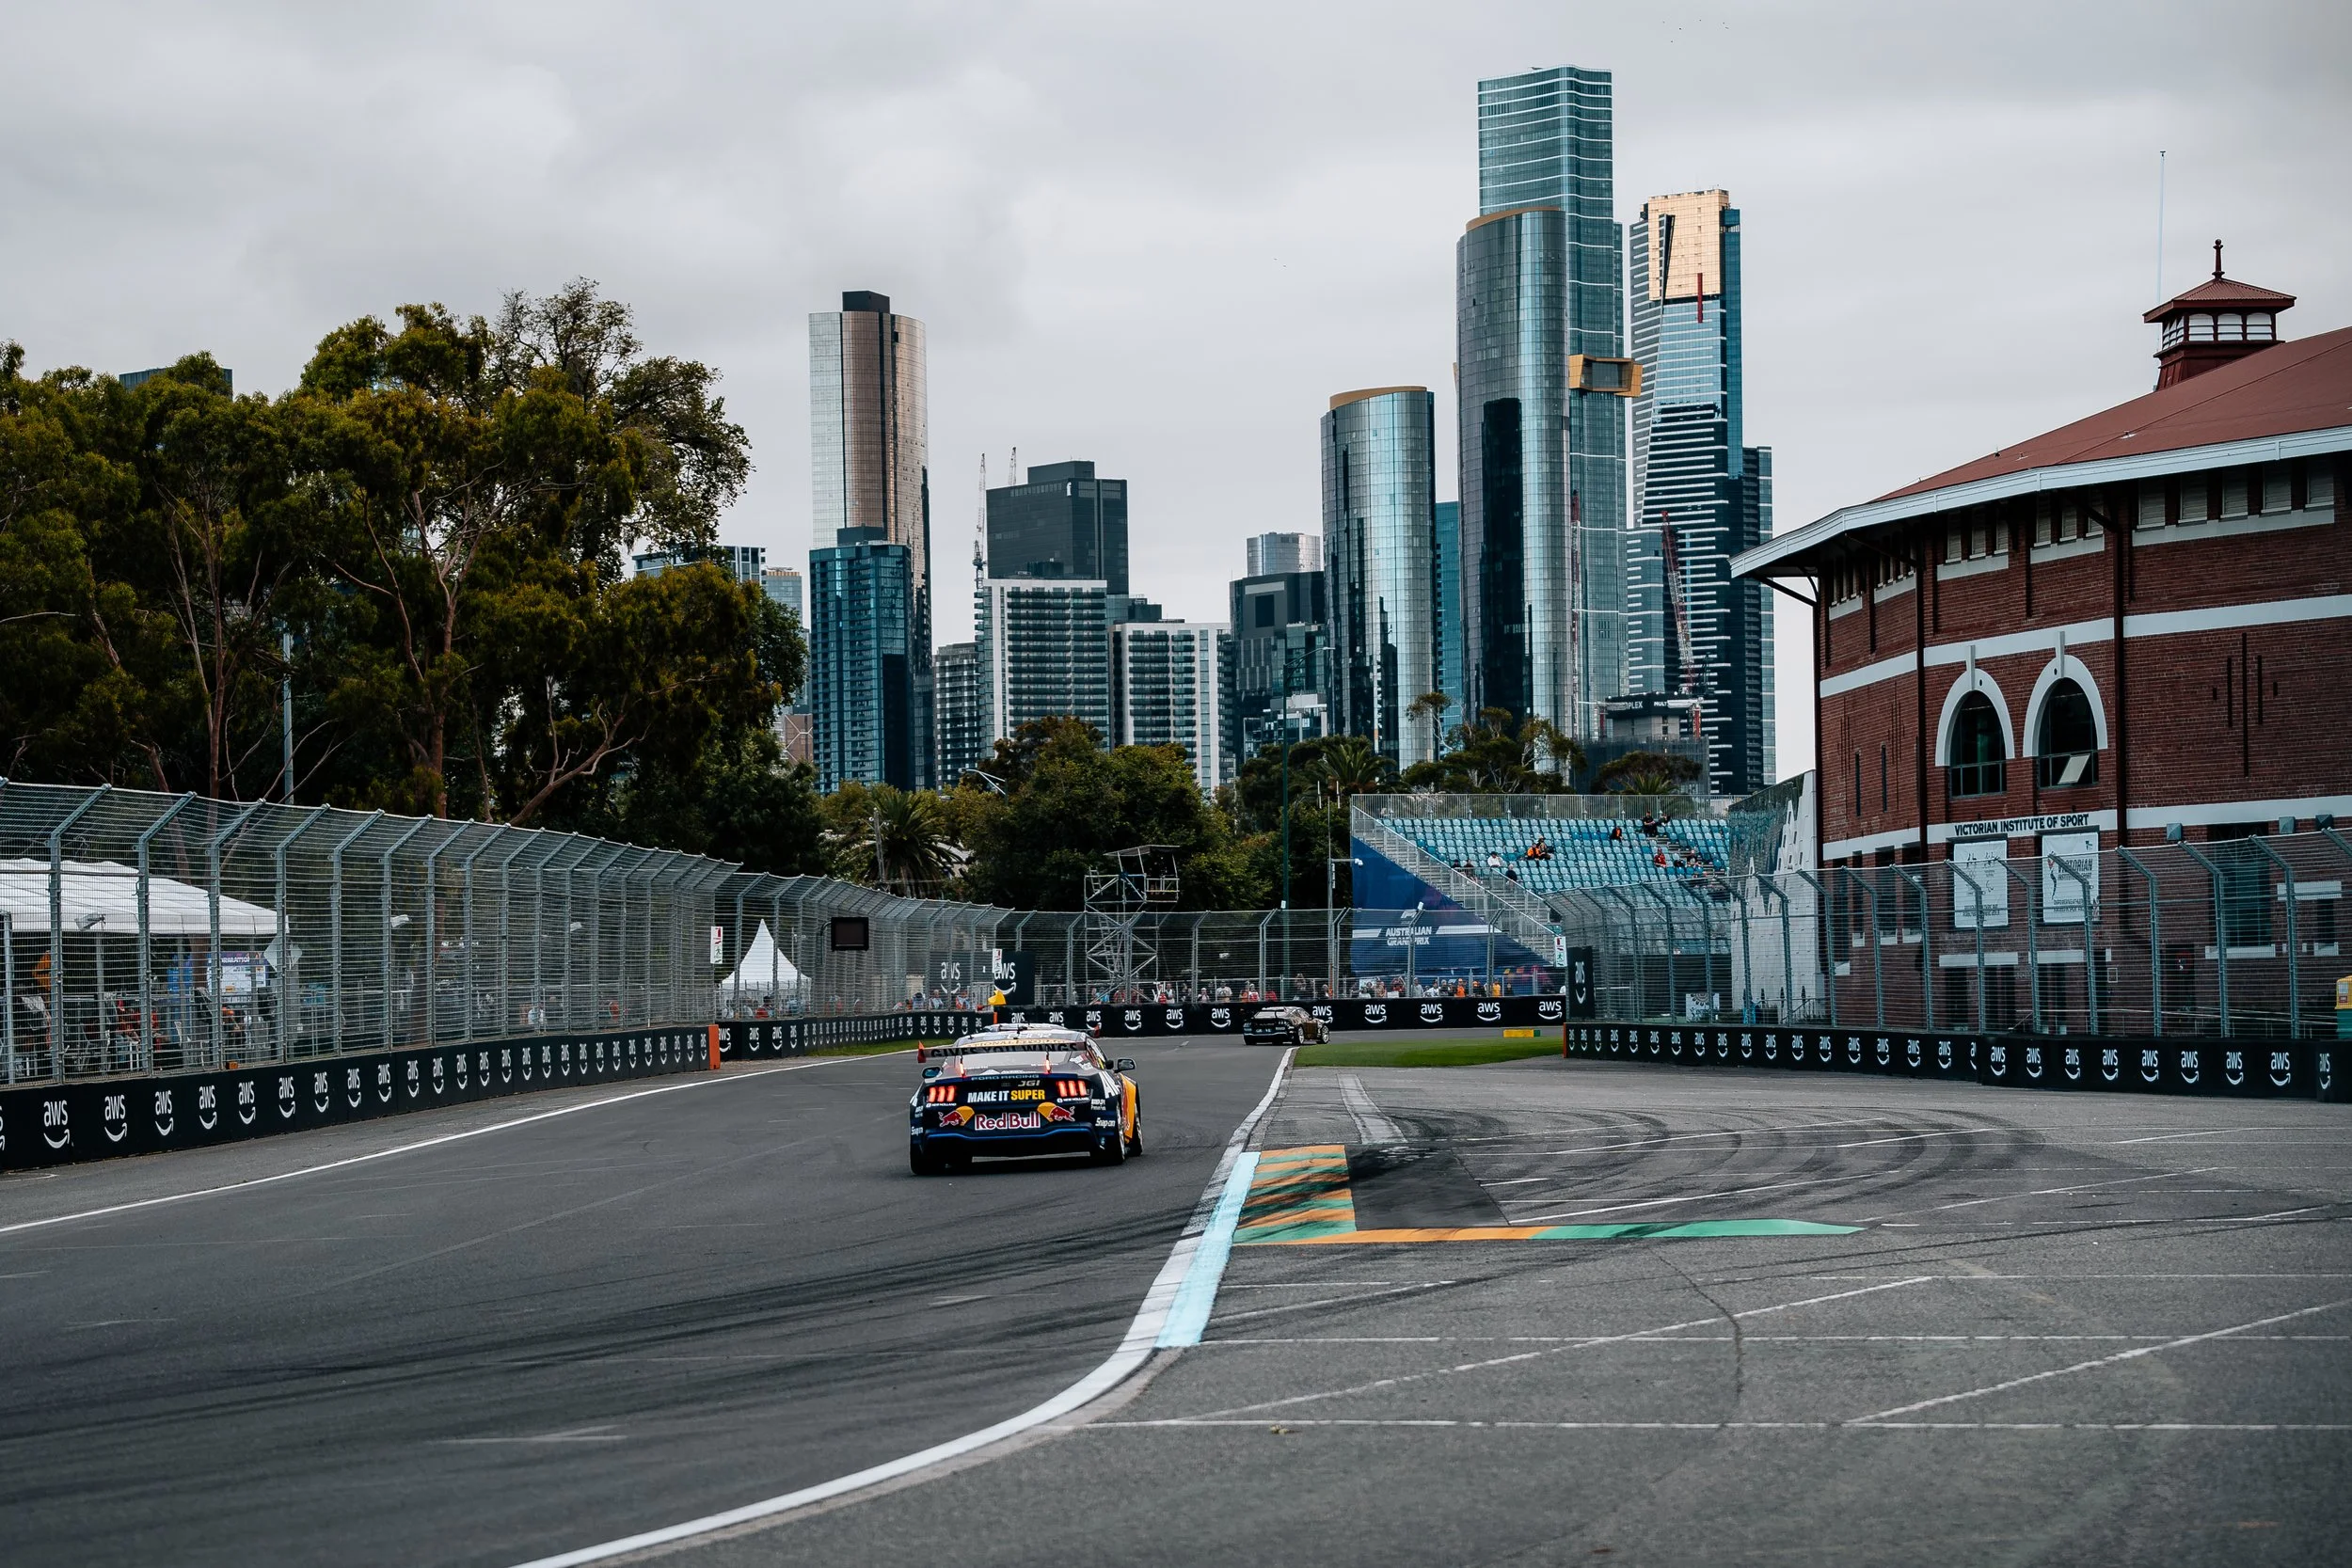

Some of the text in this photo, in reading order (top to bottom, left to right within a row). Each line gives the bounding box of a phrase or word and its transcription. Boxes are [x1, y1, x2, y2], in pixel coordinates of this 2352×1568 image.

[1955, 814, 2089, 835] VICTORIAN INSTITUTE OF SPORT
[1212, 1008, 1231, 1019] aws
[1312, 1006, 1332, 1016] aws
[1365, 1005, 1387, 1015] aws
[1421, 1004, 1443, 1014] aws
[1478, 1003, 1501, 1013] aws
[1539, 1001, 1562, 1011] aws
[1049, 1012, 1064, 1022] aws
[1087, 1011, 1102, 1022] aws
[1125, 1010, 1141, 1021] aws
[1167, 1009, 1184, 1020] aws
[750, 1028, 760, 1040] aws
[772, 1026, 783, 1039] aws
[1741, 1034, 1752, 1046] aws
[1766, 1035, 1776, 1048] aws
[1792, 1035, 1804, 1048] aws
[1820, 1037, 1832, 1050] aws
[1849, 1037, 1861, 1051] aws
[1877, 1038, 1889, 1053] aws
[1908, 1039, 1920, 1054] aws
[1939, 1041, 1951, 1055] aws
[931, 1043, 1077, 1057] GIVES YOU WINGS
[1991, 1046, 2006, 1062] aws
[2026, 1048, 2042, 1063] aws
[2066, 1049, 2080, 1065] aws
[456, 1053, 468, 1073] aws
[501, 1049, 512, 1067] aws
[2103, 1050, 2119, 1066] aws
[2142, 1050, 2159, 1067] aws
[2181, 1051, 2199, 1068] aws
[2227, 1052, 2243, 1069] aws
[2271, 1053, 2291, 1069] aws
[2320, 1053, 2330, 1072] aws
[378, 1064, 391, 1085] aws
[407, 1060, 419, 1080] aws
[433, 1057, 444, 1077] aws
[314, 1071, 328, 1094] aws
[348, 1069, 361, 1089] aws
[239, 1081, 255, 1104] aws
[279, 1076, 294, 1099] aws
[155, 1090, 173, 1115] aws
[199, 1085, 216, 1109] aws
[967, 1089, 1045, 1103] MAKE IT SUPER
[44, 1100, 69, 1127] aws
[105, 1095, 126, 1120] aws
[975, 1111, 1041, 1131] Red Bull
